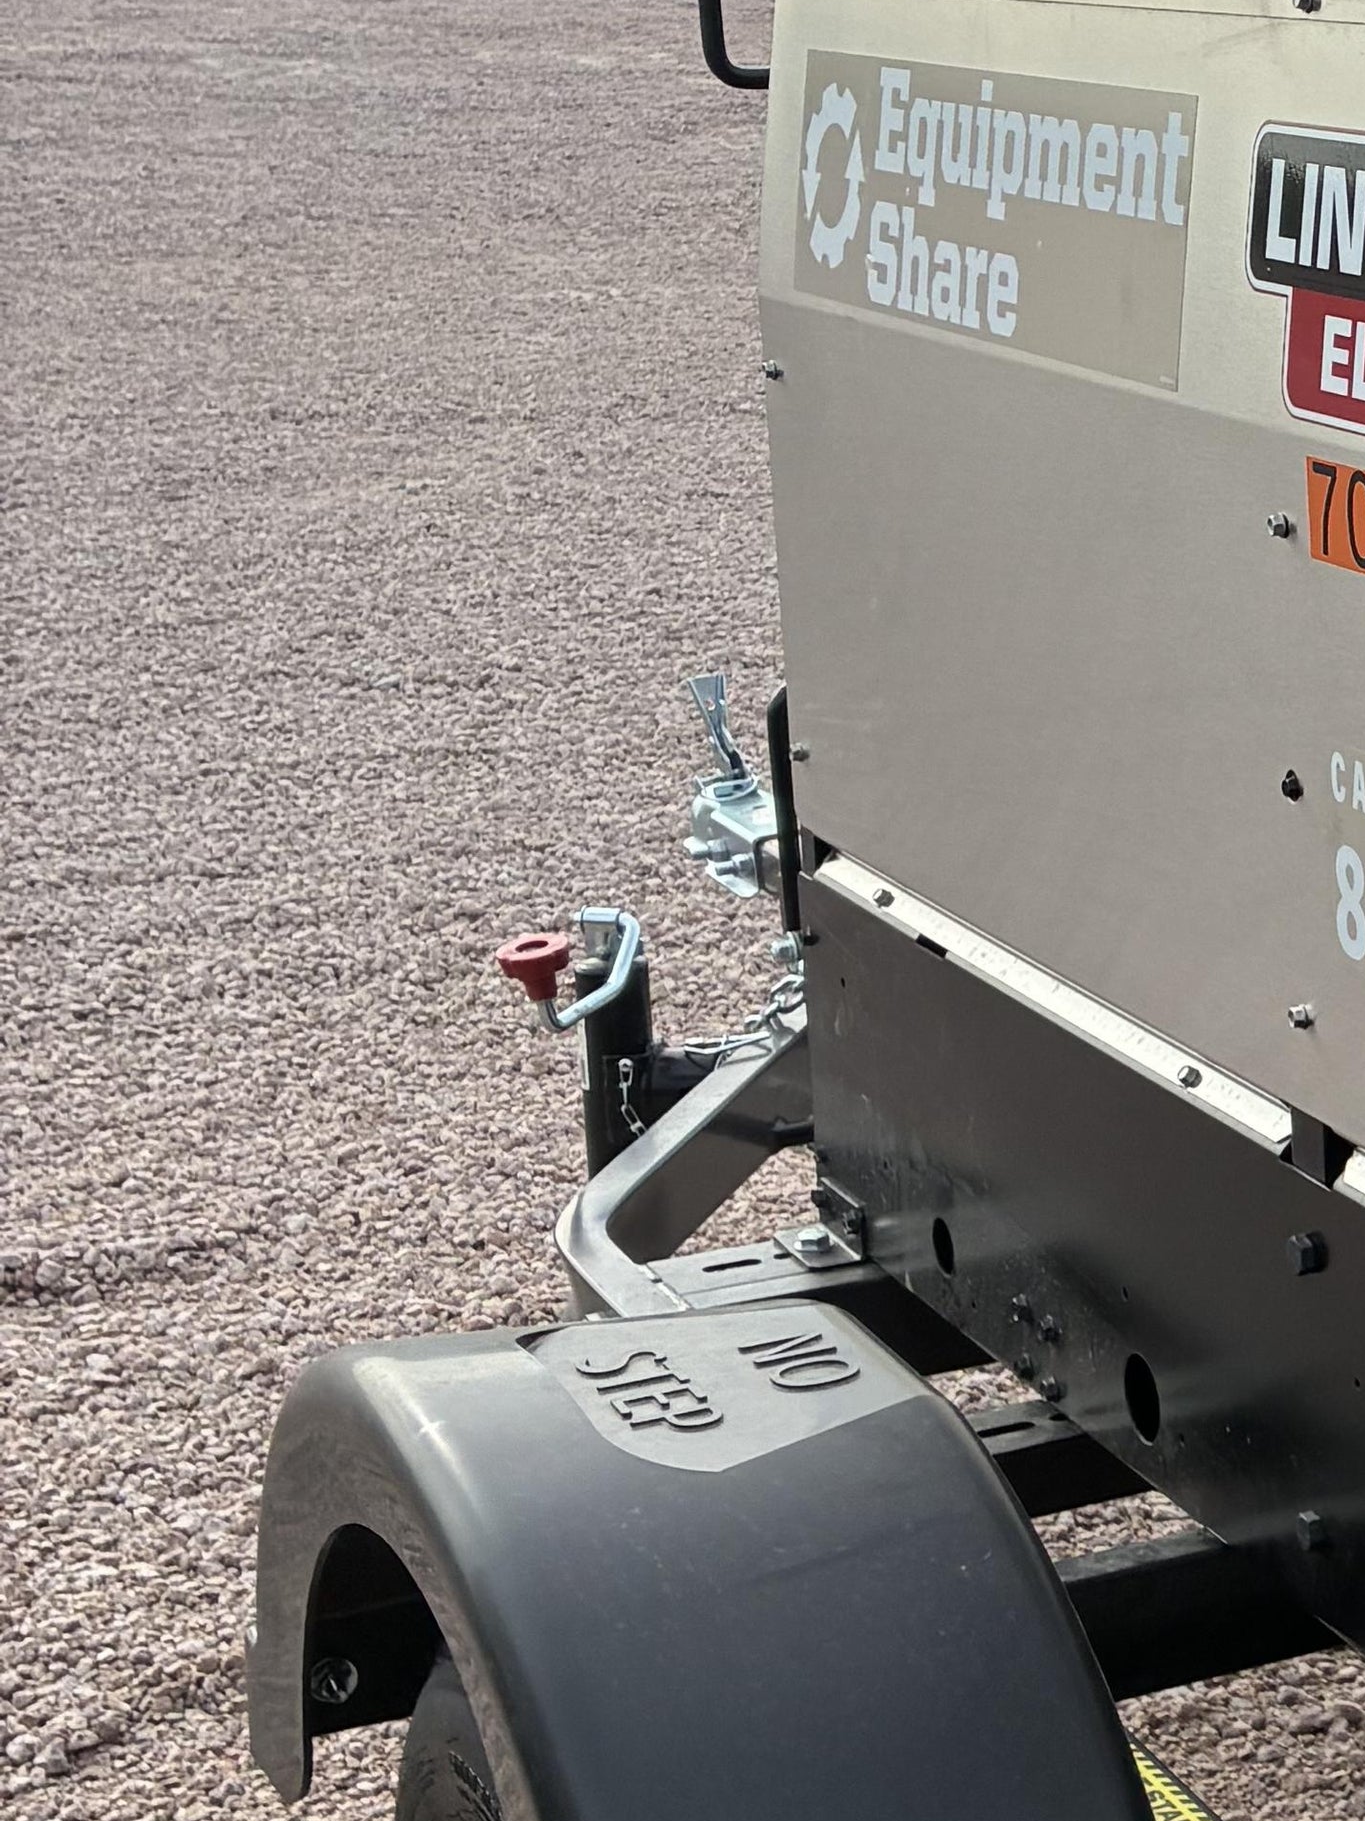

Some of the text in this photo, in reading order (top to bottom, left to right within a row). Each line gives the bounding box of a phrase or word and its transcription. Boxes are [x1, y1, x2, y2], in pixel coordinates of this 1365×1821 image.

[874, 66, 1191, 226] Equipment
[867, 202, 1020, 338] Share
[574, 1350, 725, 1432] STEP
[738, 1332, 861, 1393] NO
